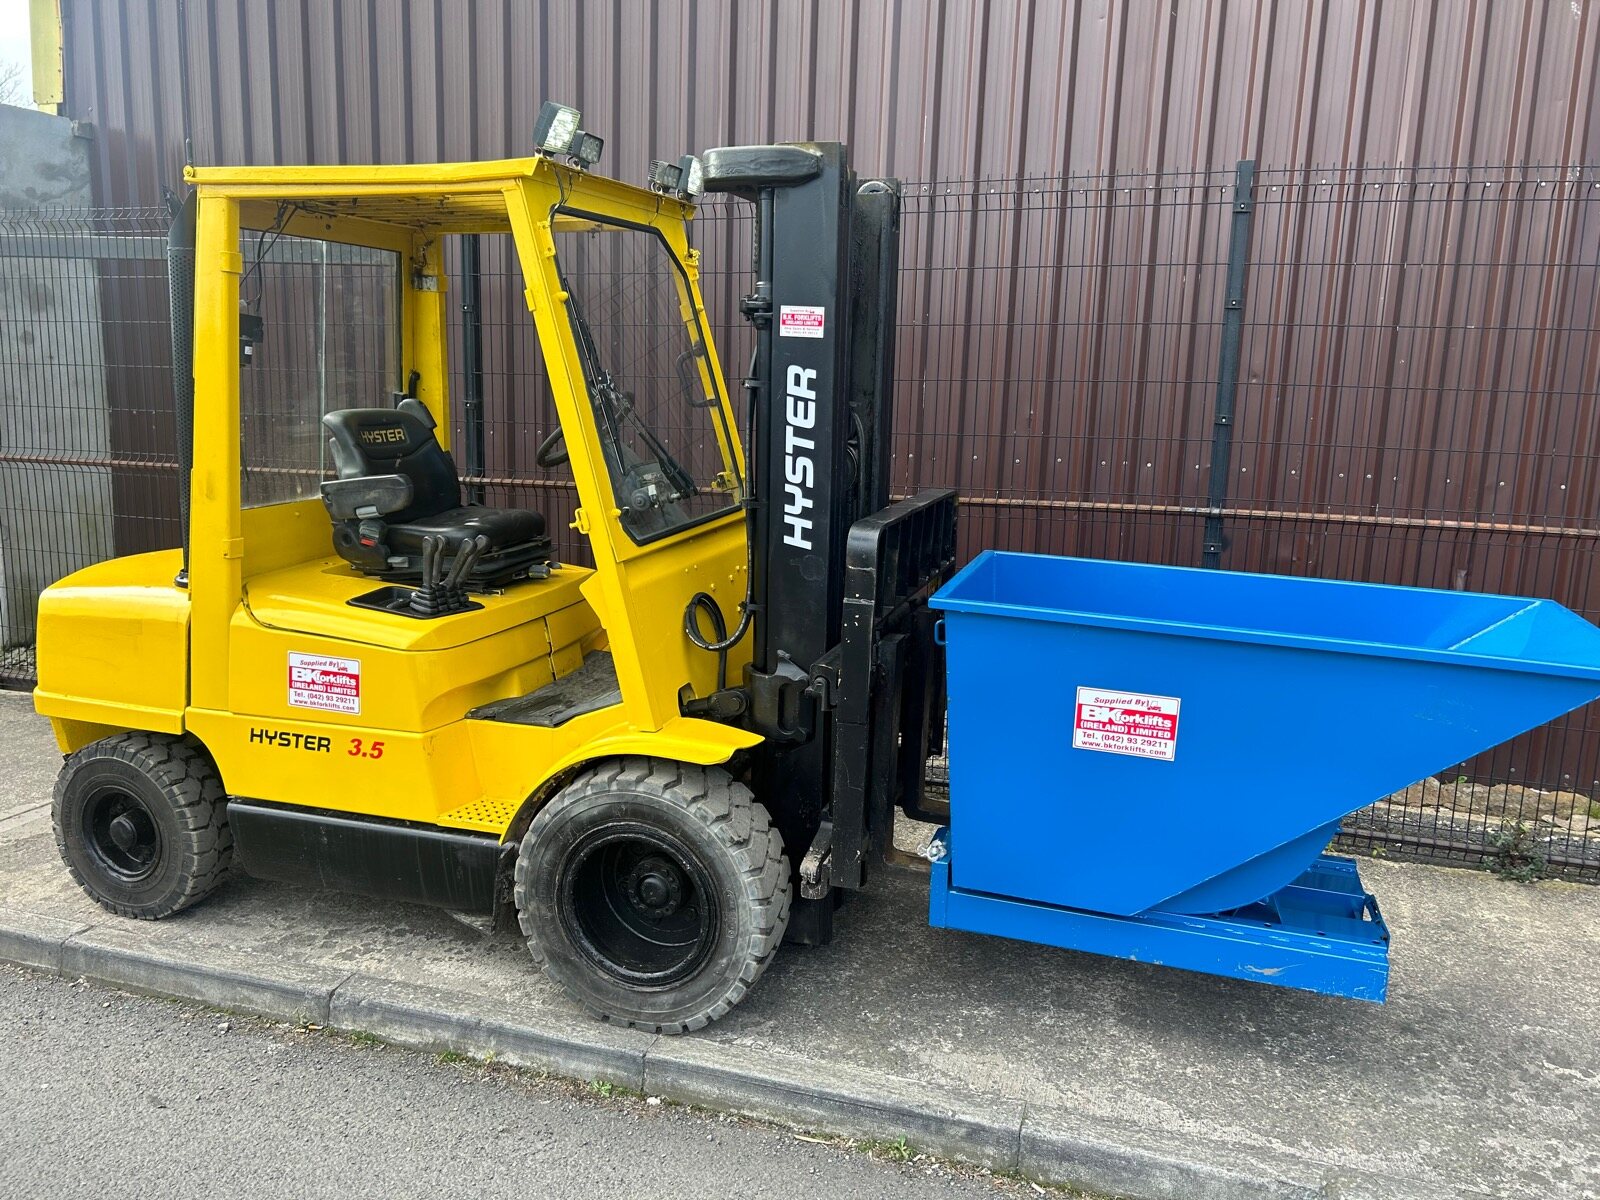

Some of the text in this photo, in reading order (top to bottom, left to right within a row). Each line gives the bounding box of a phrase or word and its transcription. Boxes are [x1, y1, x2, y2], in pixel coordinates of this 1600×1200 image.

[360, 429, 404, 443] HYSTER
[783, 365, 817, 550] HYSTER
[292, 681, 326, 692] (IRELAND)
[328, 686, 356, 695] LIMITED
[308, 693, 324, 701] (042)
[1094, 697, 1132, 705] Supplied
[294, 699, 355, 711] www.bkforklifts.com
[1081, 720, 1128, 733] (IRELAND)
[1130, 727, 1171, 738] LIMITED
[250, 728, 384, 759] HYSTER 3.5
[1082, 732, 1098, 740] Tel.
[1102, 734, 1124, 744] (042)
[1141, 739, 1167, 748] 29211
[1081, 740, 1166, 756] www.bkforklifts.com
